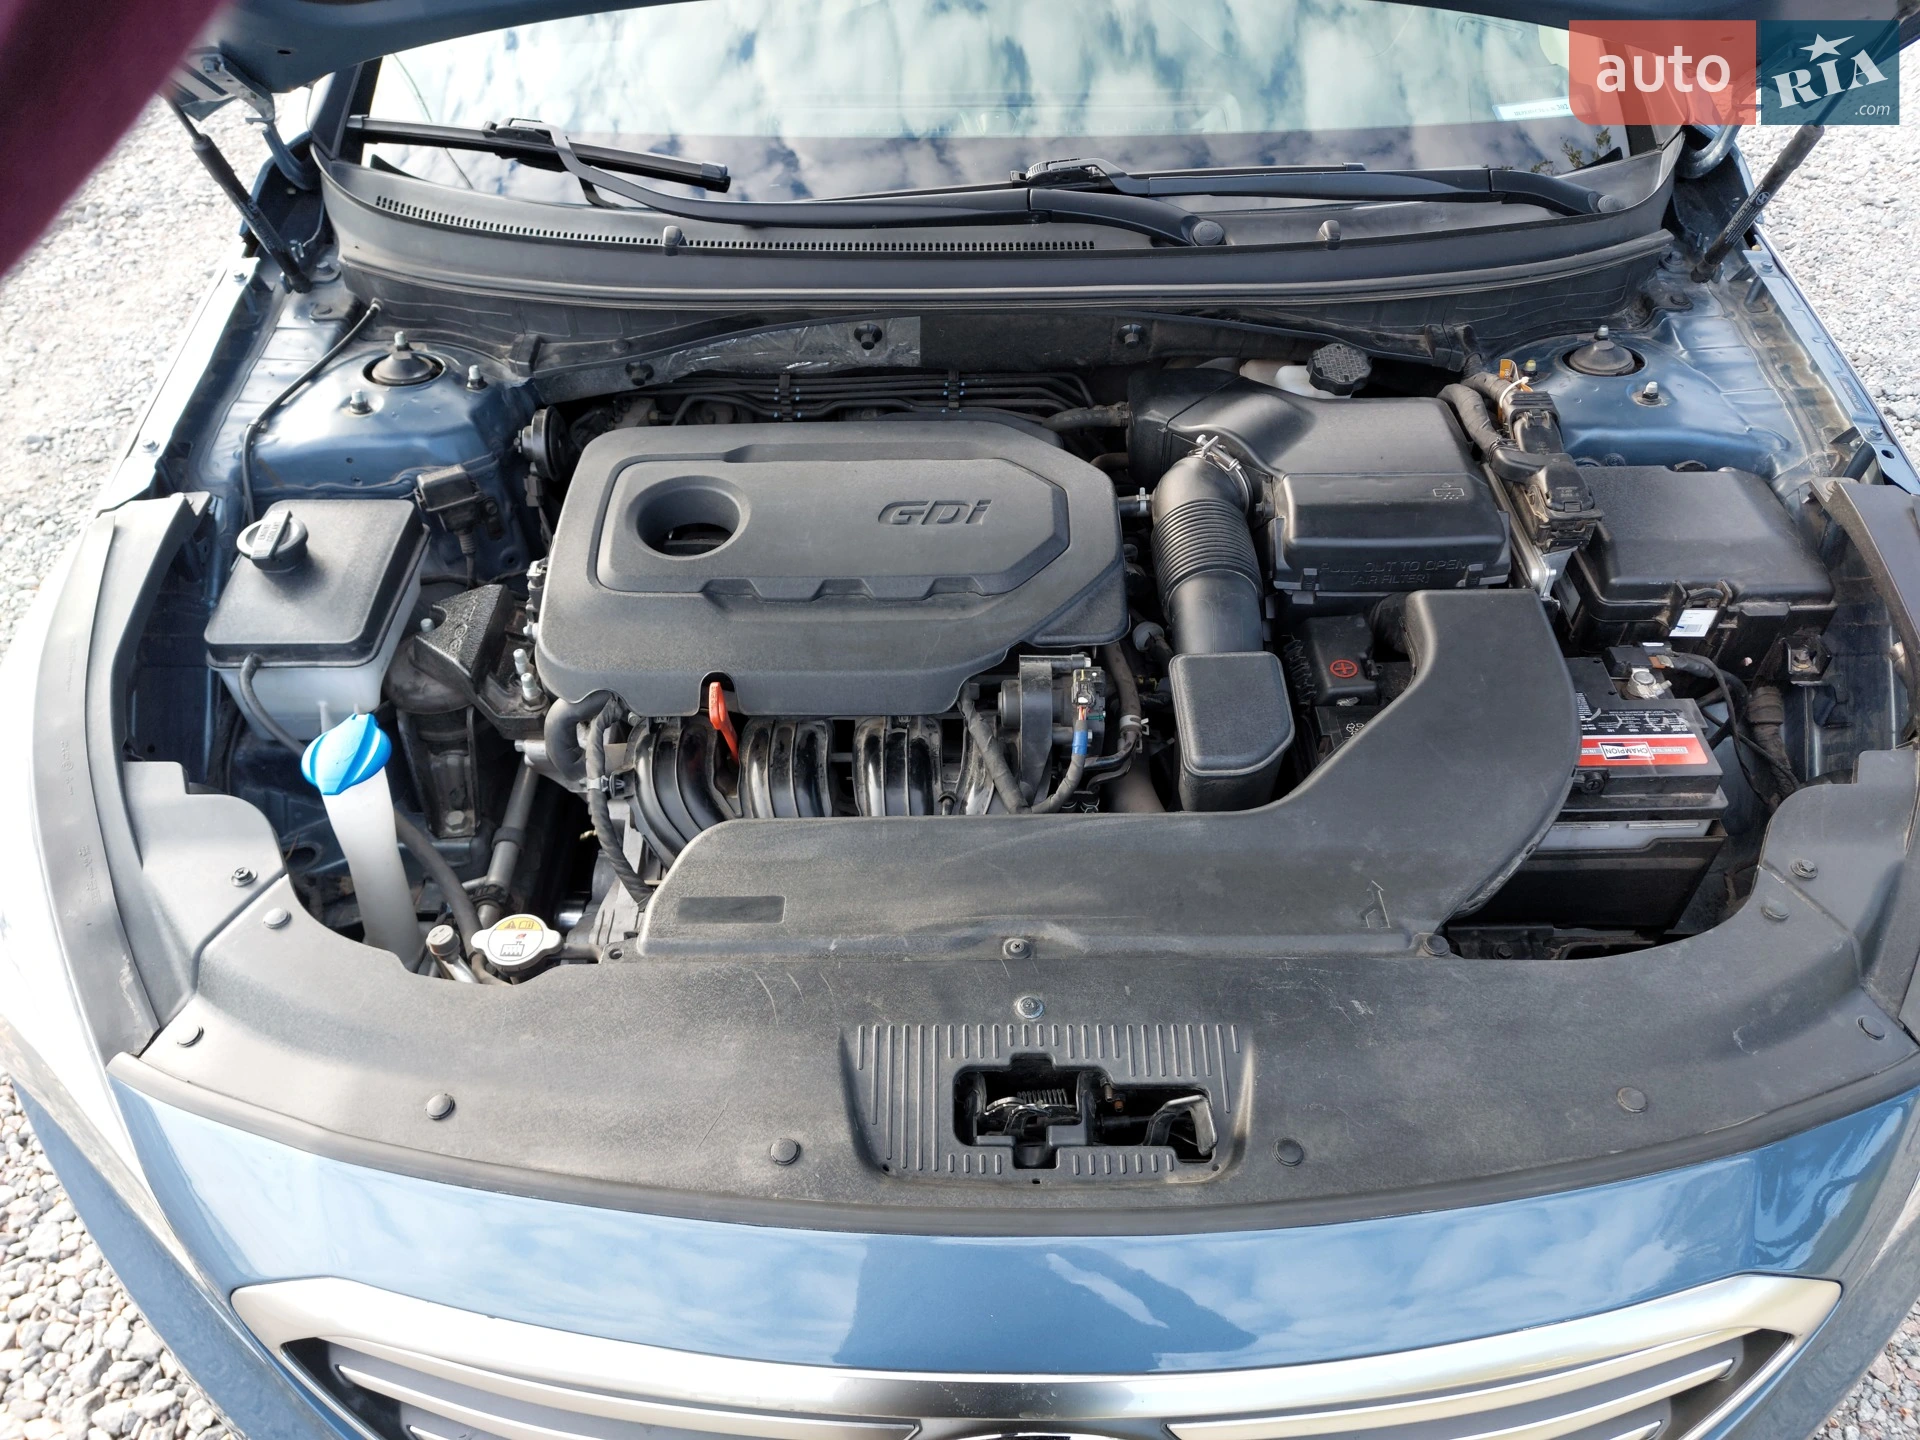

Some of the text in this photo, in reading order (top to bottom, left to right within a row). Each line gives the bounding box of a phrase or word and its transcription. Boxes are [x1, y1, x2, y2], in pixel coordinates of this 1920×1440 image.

[878, 500, 992, 525] GDi
[1319, 559, 1468, 573] PULL OUT TO OPEN
[1605, 746, 1649, 755] CHAMPION
